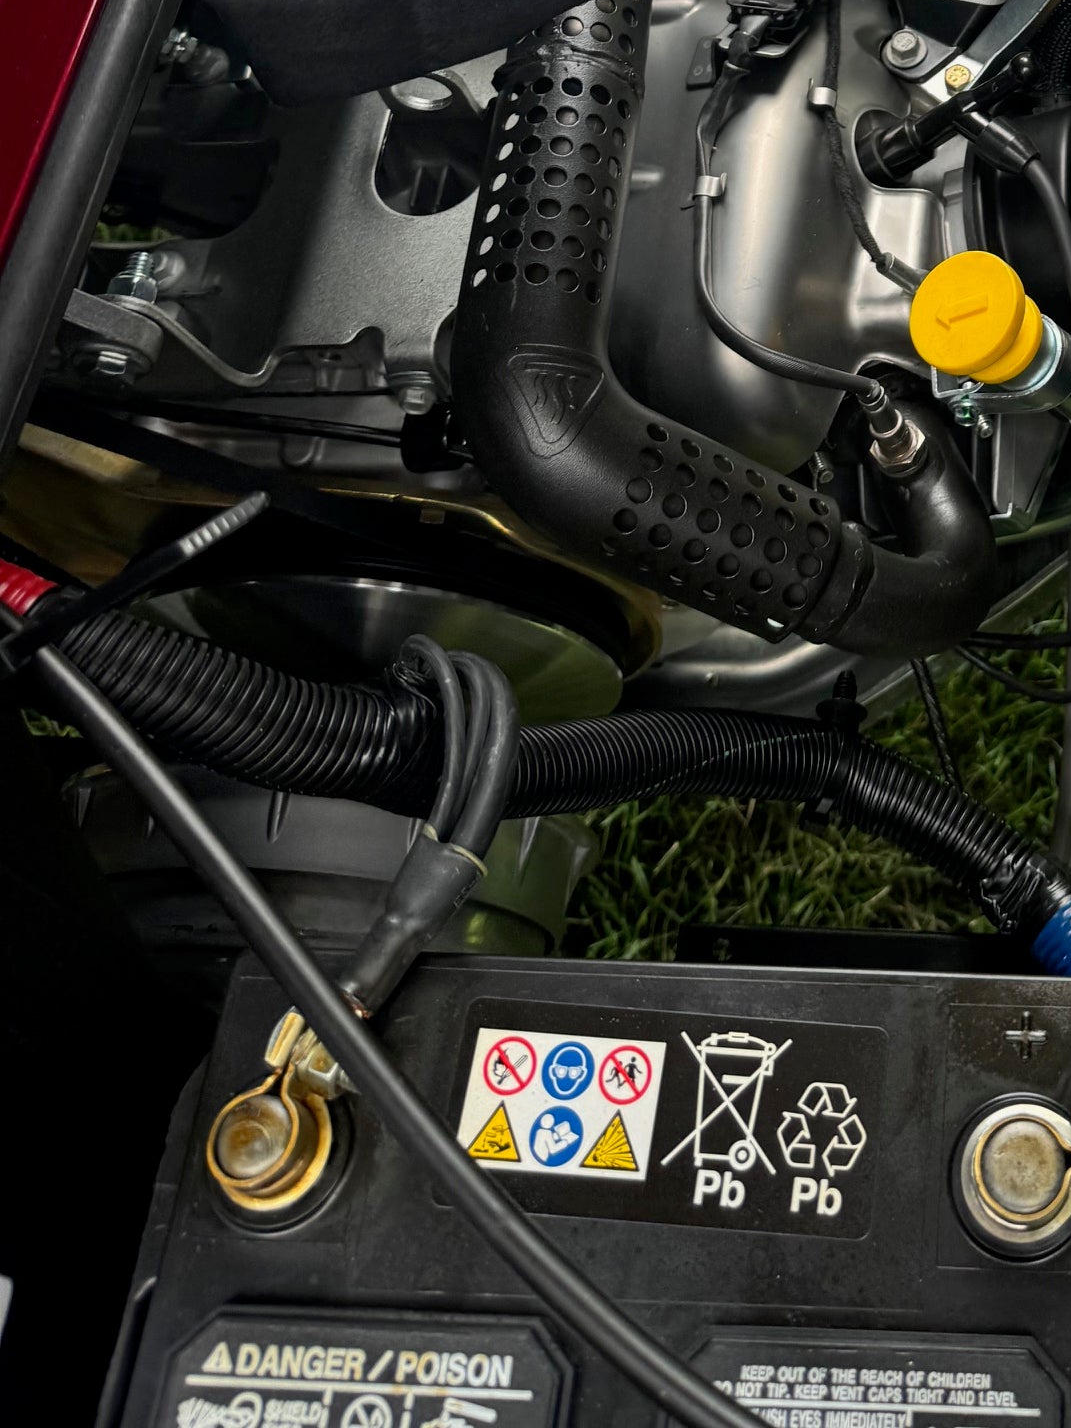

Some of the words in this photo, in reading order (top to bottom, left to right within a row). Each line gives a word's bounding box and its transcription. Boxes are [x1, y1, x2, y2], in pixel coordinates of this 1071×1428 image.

[693, 1170, 747, 1210] Pb
[790, 1176, 844, 1218] Pb
[236, 1343, 367, 1381] DANGER
[367, 1350, 394, 1381] /
[394, 1350, 514, 1387] POISON
[740, 1364, 775, 1382] KEEP
[777, 1366, 806, 1383] OUT
[808, 1367, 828, 1383] OF
[830, 1368, 856, 1384] THE
[860, 1369, 902, 1386] REACH
[906, 1371, 925, 1386] OF
[927, 1372, 992, 1390] CHILDREN
[736, 1382, 762, 1397] NOT
[766, 1382, 790, 1398] TIP.
[794, 1384, 828, 1400] KEEP
[831, 1386, 864, 1401] VENT
[868, 1387, 902, 1402] CAPS
[906, 1388, 945, 1404] TIGHT
[948, 1390, 974, 1406] AND
[978, 1391, 1018, 1407] LEVEL
[264, 1398, 322, 1425] SHIELD
[790, 1410, 822, 1428] EYES
[825, 1410, 906, 1428] IMMEDIATELY
